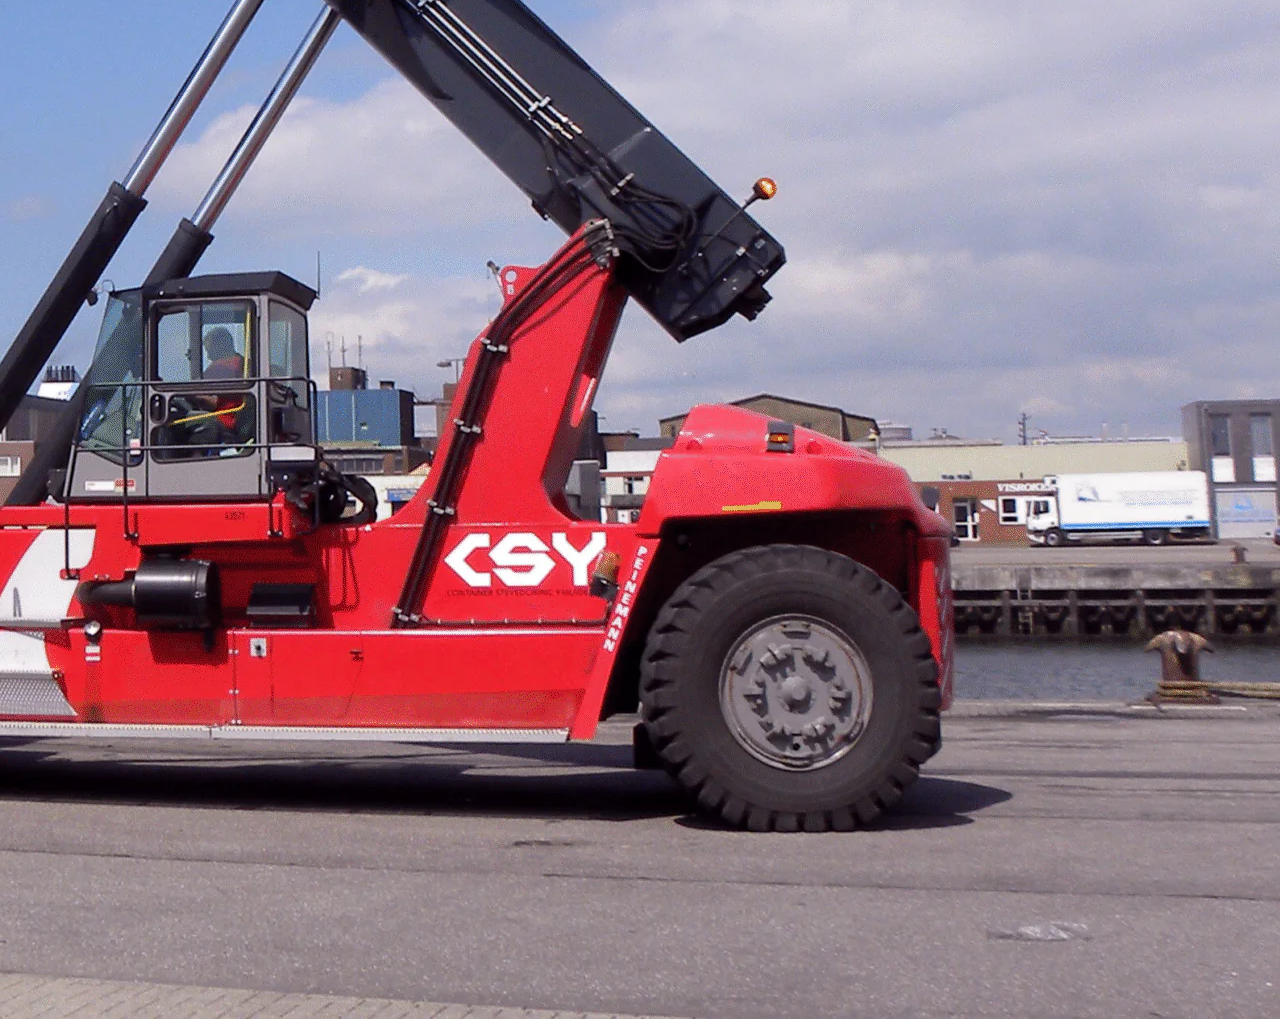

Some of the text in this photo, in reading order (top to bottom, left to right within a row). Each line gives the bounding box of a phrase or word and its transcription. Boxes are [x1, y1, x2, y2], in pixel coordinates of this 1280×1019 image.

[444, 531, 607, 587] CSY
[447, 589, 493, 597] CONTAINER
[602, 545, 649, 653] PEINEMANN
